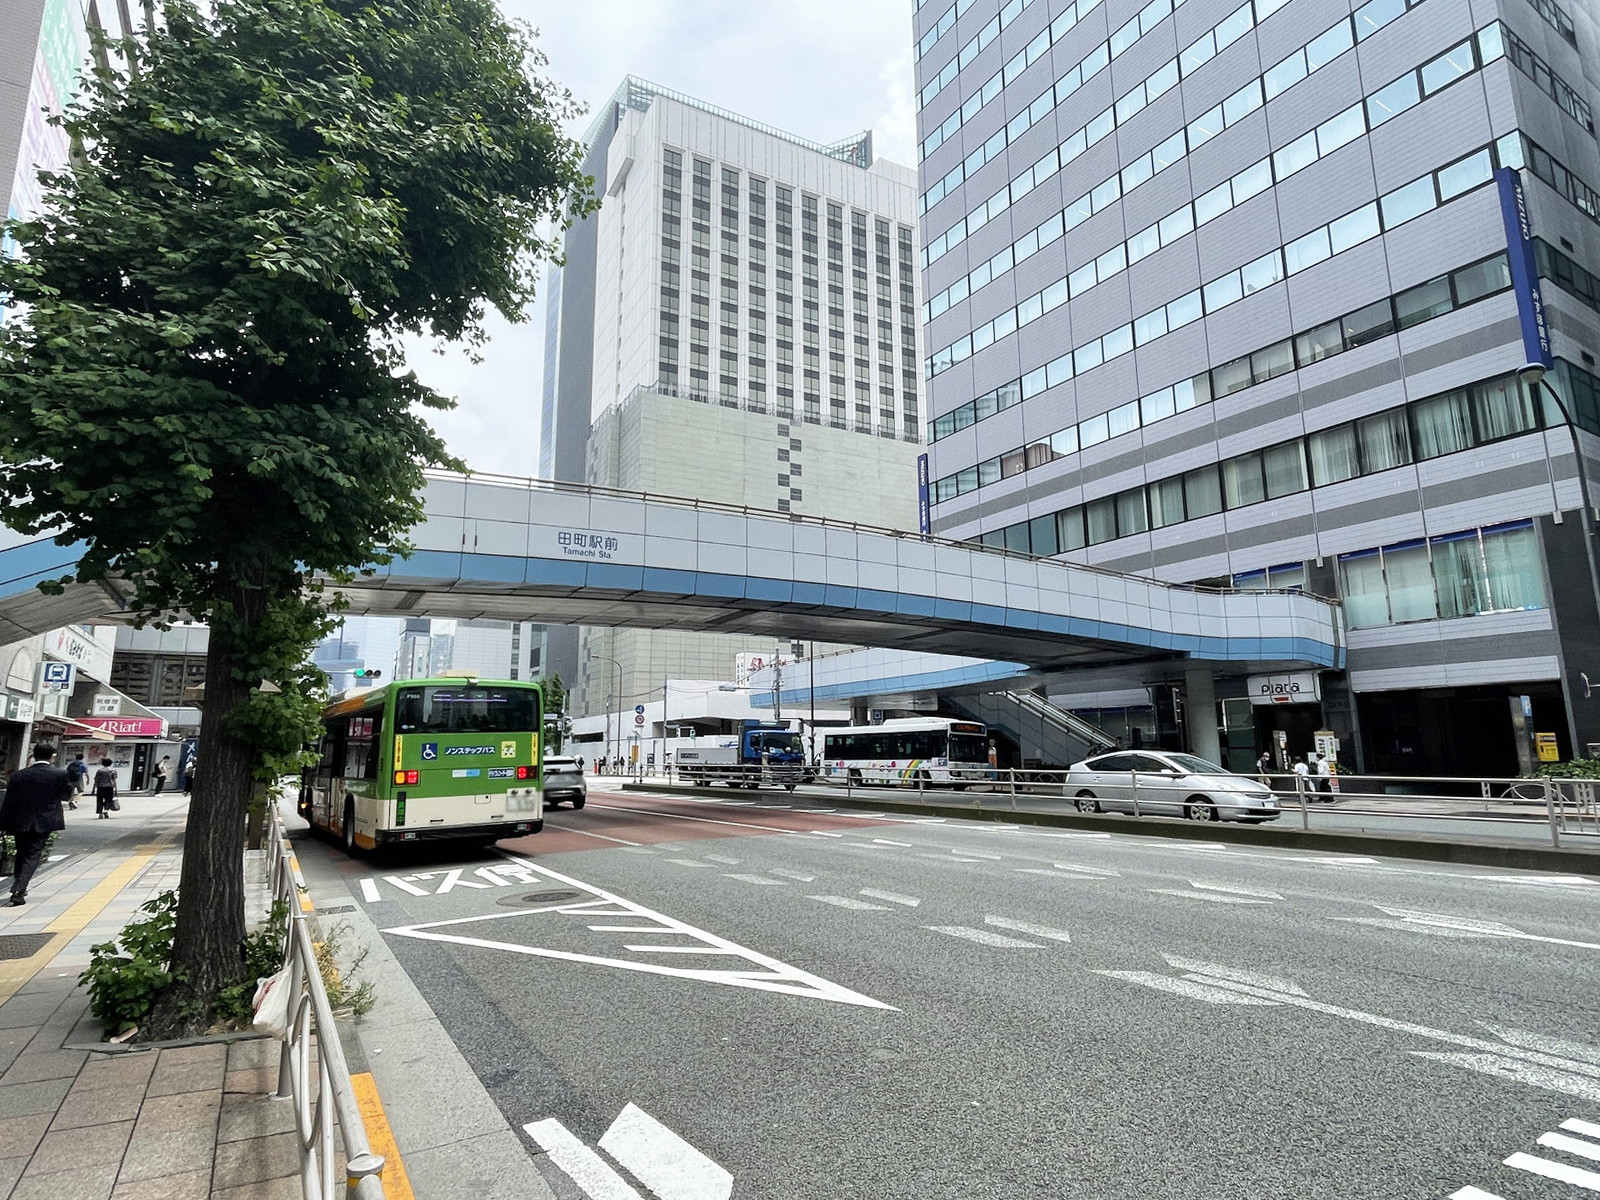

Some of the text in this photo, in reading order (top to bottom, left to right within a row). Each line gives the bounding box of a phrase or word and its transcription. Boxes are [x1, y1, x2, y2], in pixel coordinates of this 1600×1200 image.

[1514, 184, 1531, 241] MIZUHO
[558, 532, 619, 551] 田町駅前
[562, 547, 596, 557] Tamachi
[445, 746, 495, 755] ノンステップバス
[359, 863, 542, 903] バス停
